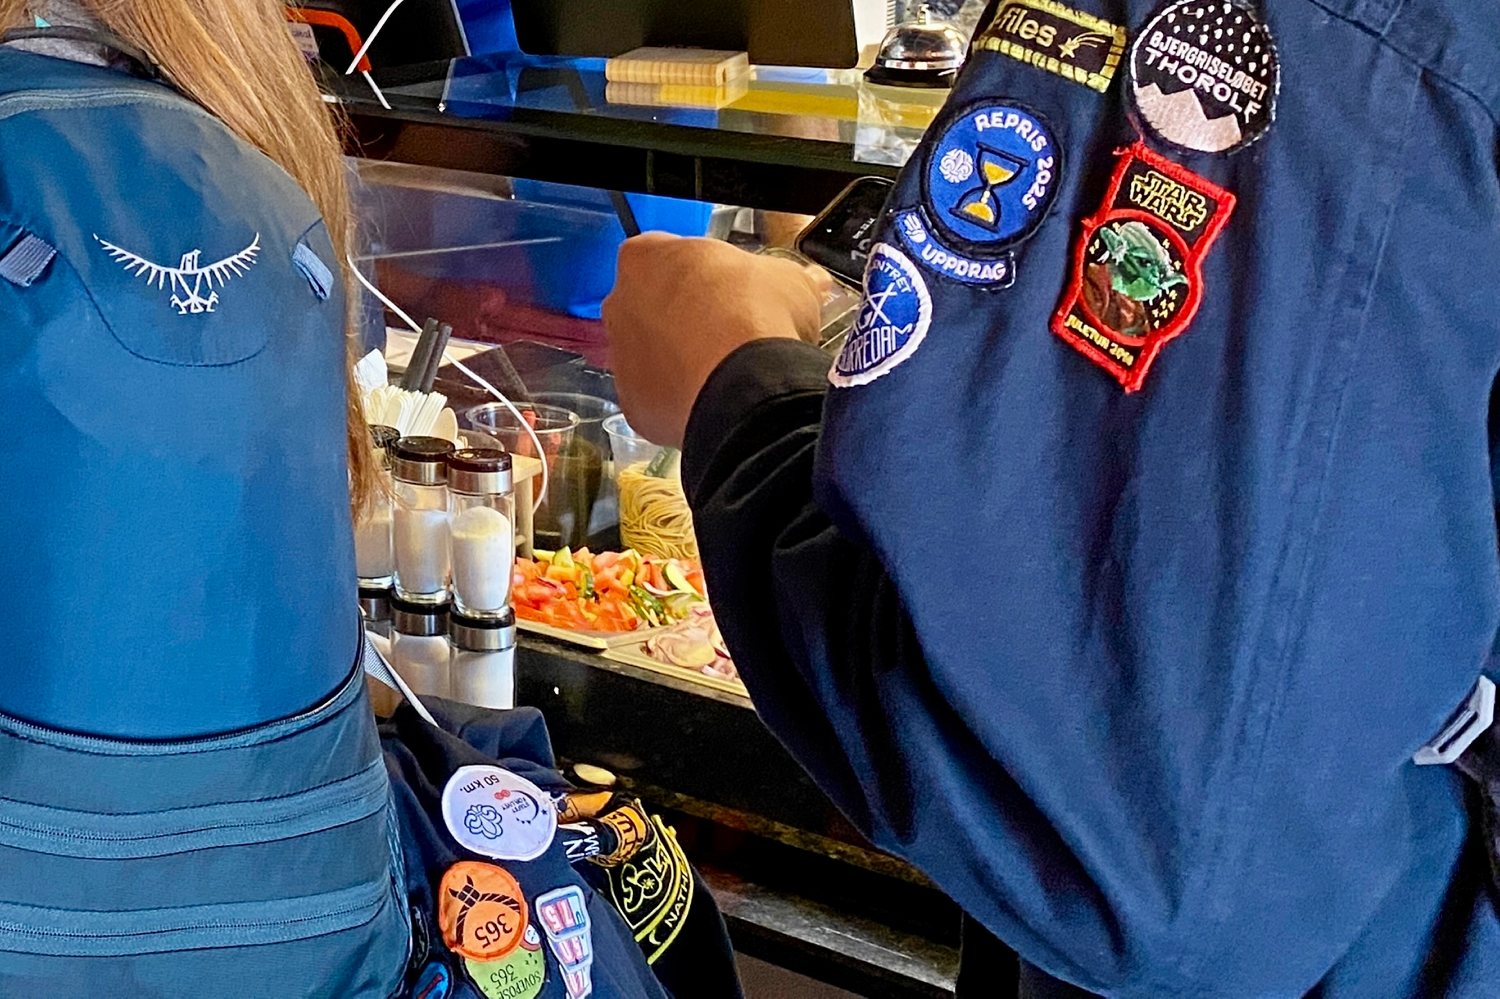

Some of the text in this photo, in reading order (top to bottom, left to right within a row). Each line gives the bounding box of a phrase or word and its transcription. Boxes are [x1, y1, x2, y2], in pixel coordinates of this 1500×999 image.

[1144, 46, 1262, 123] THOROLF
[974, 112, 1053, 211] REPRIS 2025
[1130, 181, 1206, 231] WARS
[1134, 170, 1207, 214] STAR
[1064, 314, 1110, 351] JULETUR
[460, 775, 500, 793] 50 km.
[475, 913, 513, 949] 365
[490, 963, 518, 989] 365
